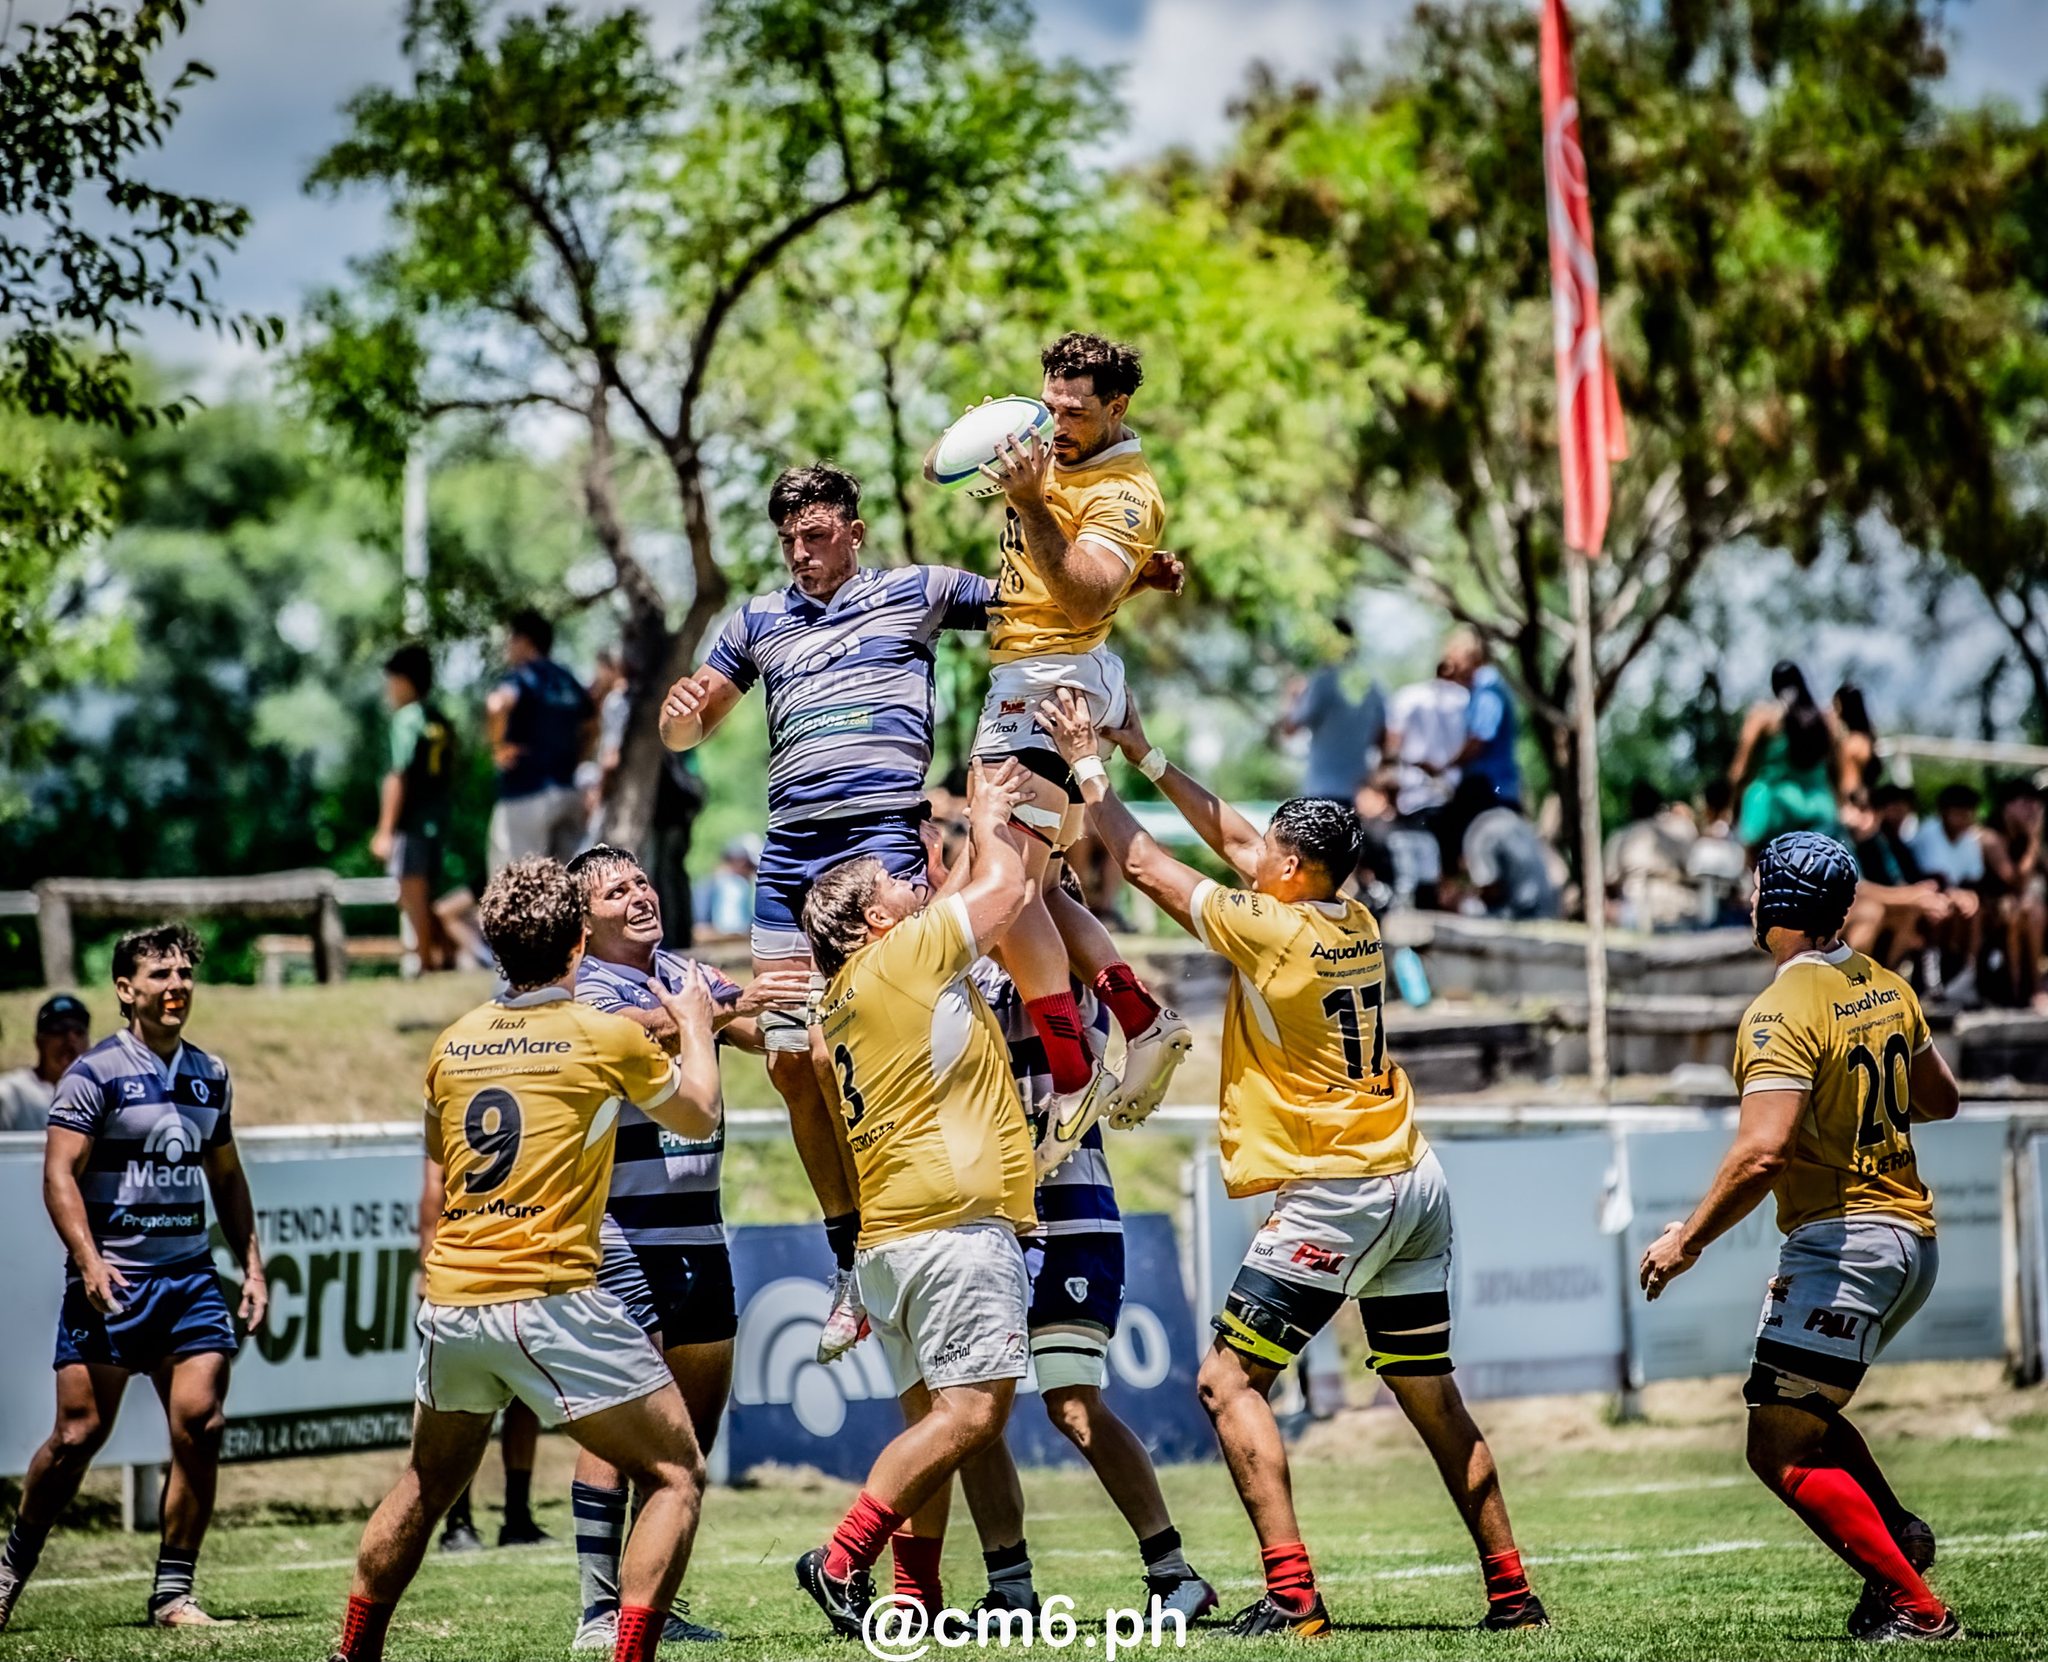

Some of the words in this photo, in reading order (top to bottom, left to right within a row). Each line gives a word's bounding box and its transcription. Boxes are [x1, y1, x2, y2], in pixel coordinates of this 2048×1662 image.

[1749, 1012, 1785, 1026] flash
[1833, 989, 1901, 1021] AquaMare
[488, 1018, 527, 1031] flash
[1321, 980, 1386, 1081] 17
[444, 1037, 572, 1061] AquaMare
[1847, 1033, 1912, 1150] 20
[465, 1086, 522, 1196] 9
[257, 1207, 342, 1244] TIENDA
[353, 1202, 383, 1239] DE
[392, 1201, 420, 1236] RU
[207, 1222, 421, 1367] Scru
[1803, 1307, 1859, 1340] PAL
[933, 1347, 970, 1369] Imperial
[268, 1425, 291, 1453] LA
